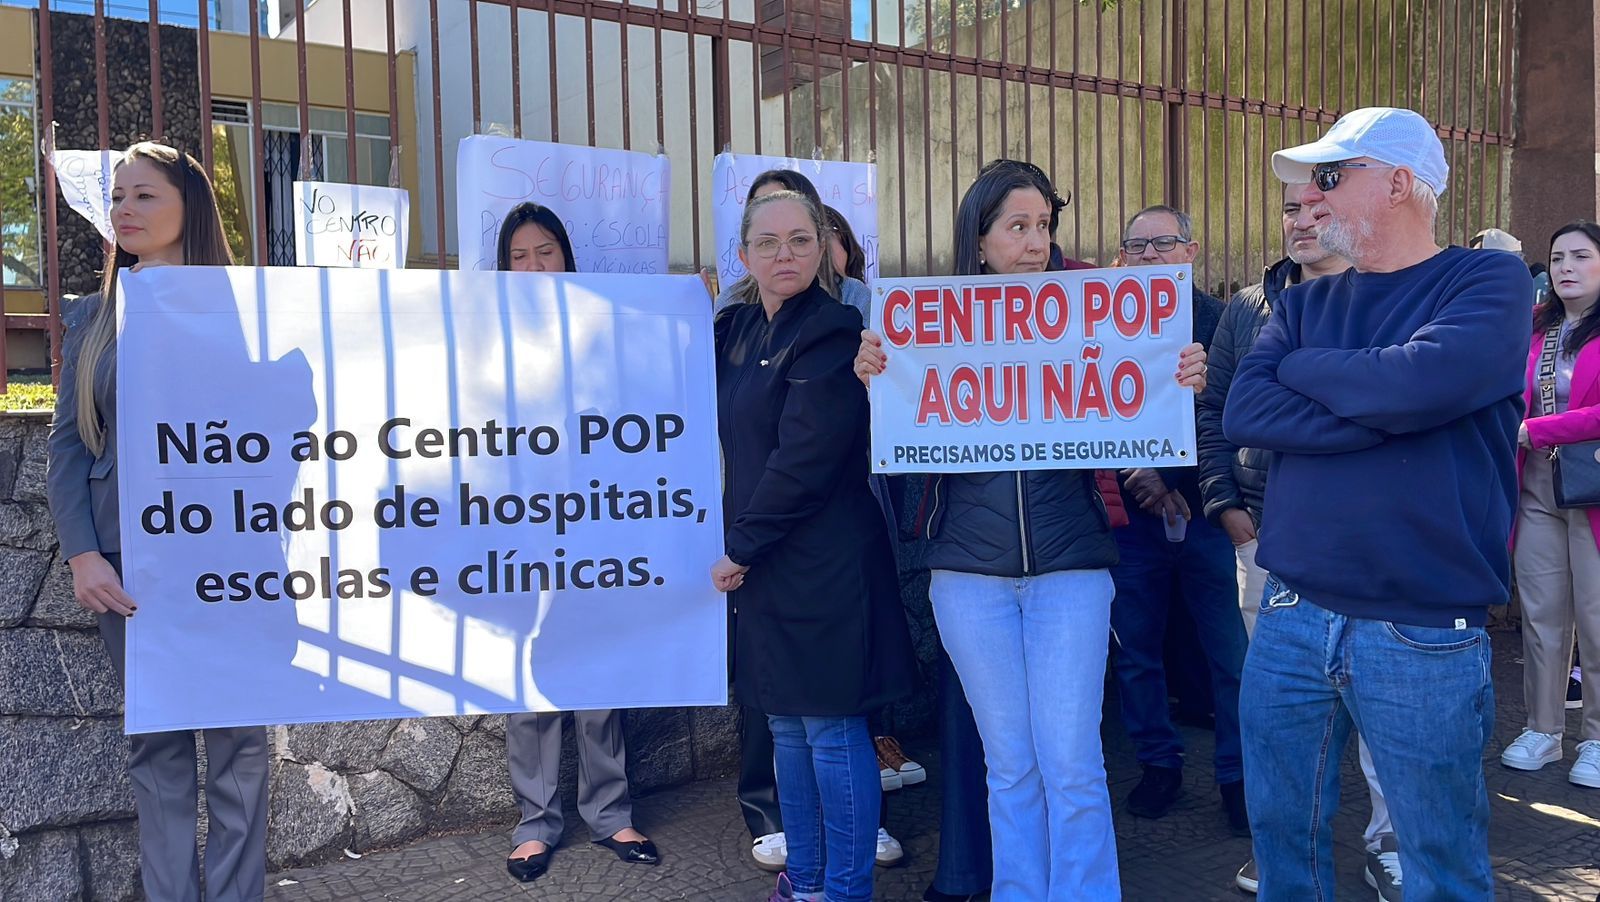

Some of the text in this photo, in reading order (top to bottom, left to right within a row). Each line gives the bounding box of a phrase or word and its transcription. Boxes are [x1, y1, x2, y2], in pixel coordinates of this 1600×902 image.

[482, 145, 668, 211] SEGURANÇA
[306, 210, 396, 237] CENTRO
[337, 239, 390, 262] NÃO
[882, 276, 1178, 347] CENTRO POP
[915, 344, 1146, 424] AQUI NÃO
[156, 413, 685, 465] Não ao Centro POP
[894, 438, 1175, 464] PRECISAMOS DE SEGURANÇA
[141, 477, 707, 536] do lado de hospitais,
[195, 548, 665, 602] escolas e clínicas.
